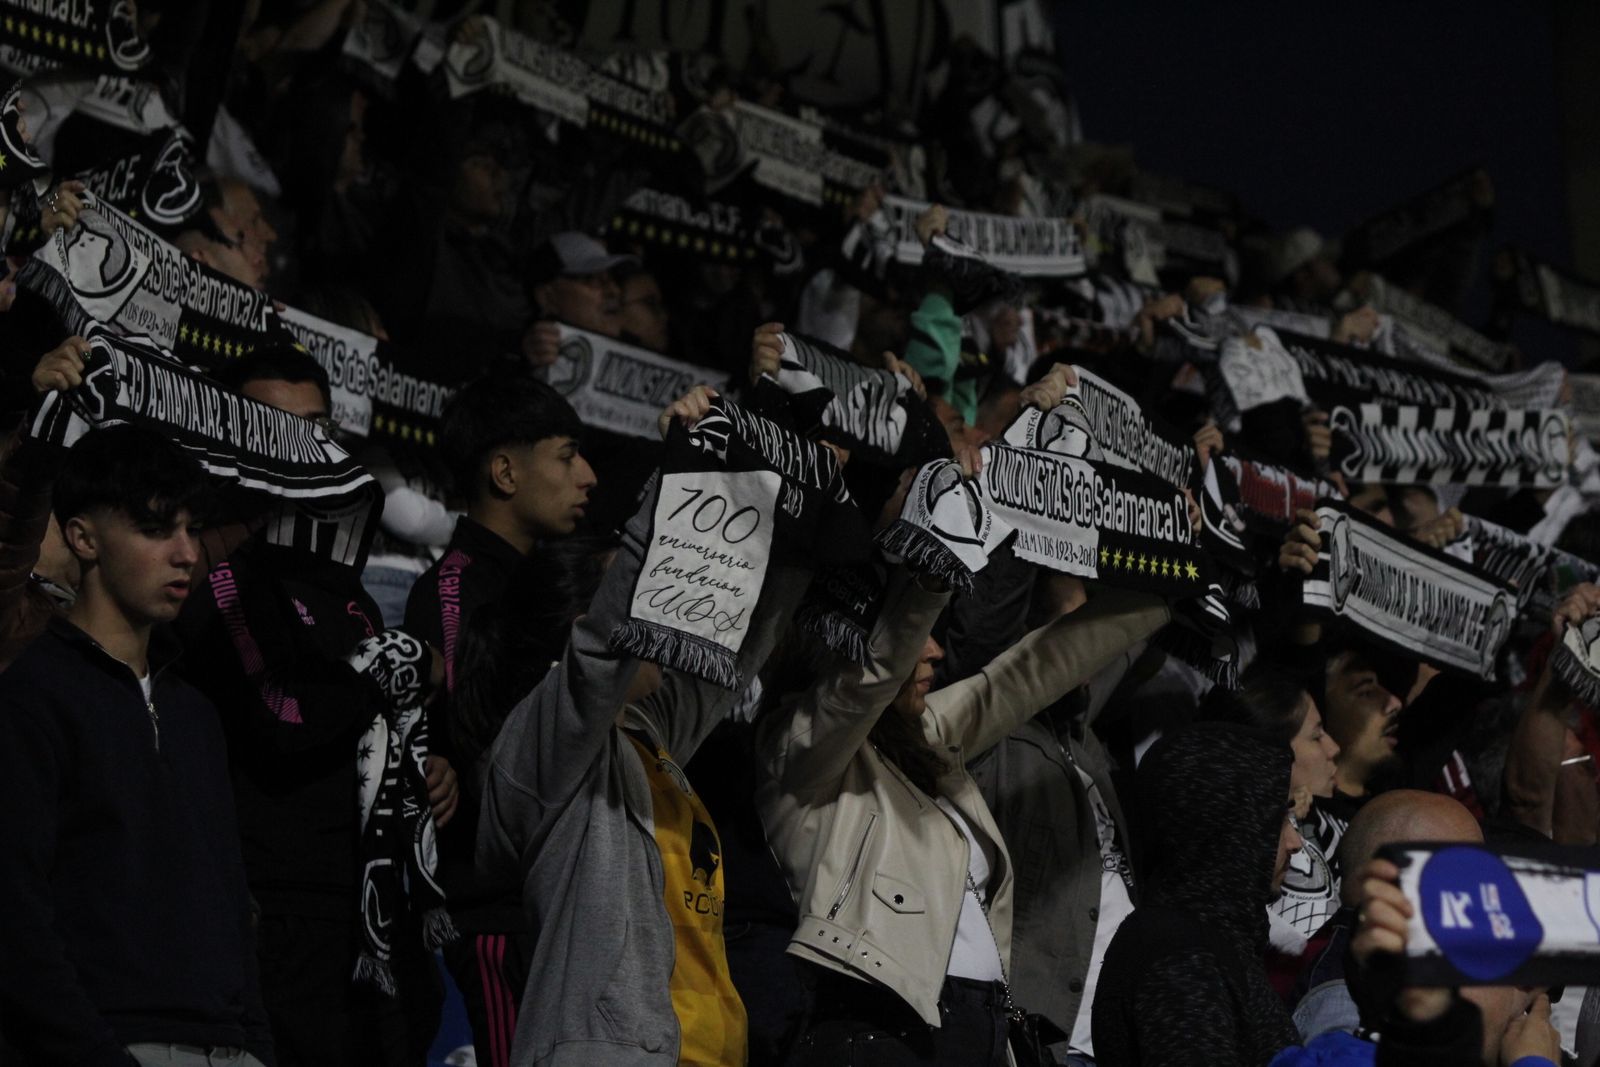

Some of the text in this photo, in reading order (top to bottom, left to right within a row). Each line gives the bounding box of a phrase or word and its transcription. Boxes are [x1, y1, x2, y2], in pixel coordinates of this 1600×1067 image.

[162, 250, 182, 304] de
[180, 254, 254, 334] Salamanca
[345, 350, 367, 396] de
[987, 445, 1075, 525] UNIONISTAS
[1073, 470, 1097, 529] de
[1094, 474, 1175, 542] Salamanca
[658, 534, 756, 571] aniversario
